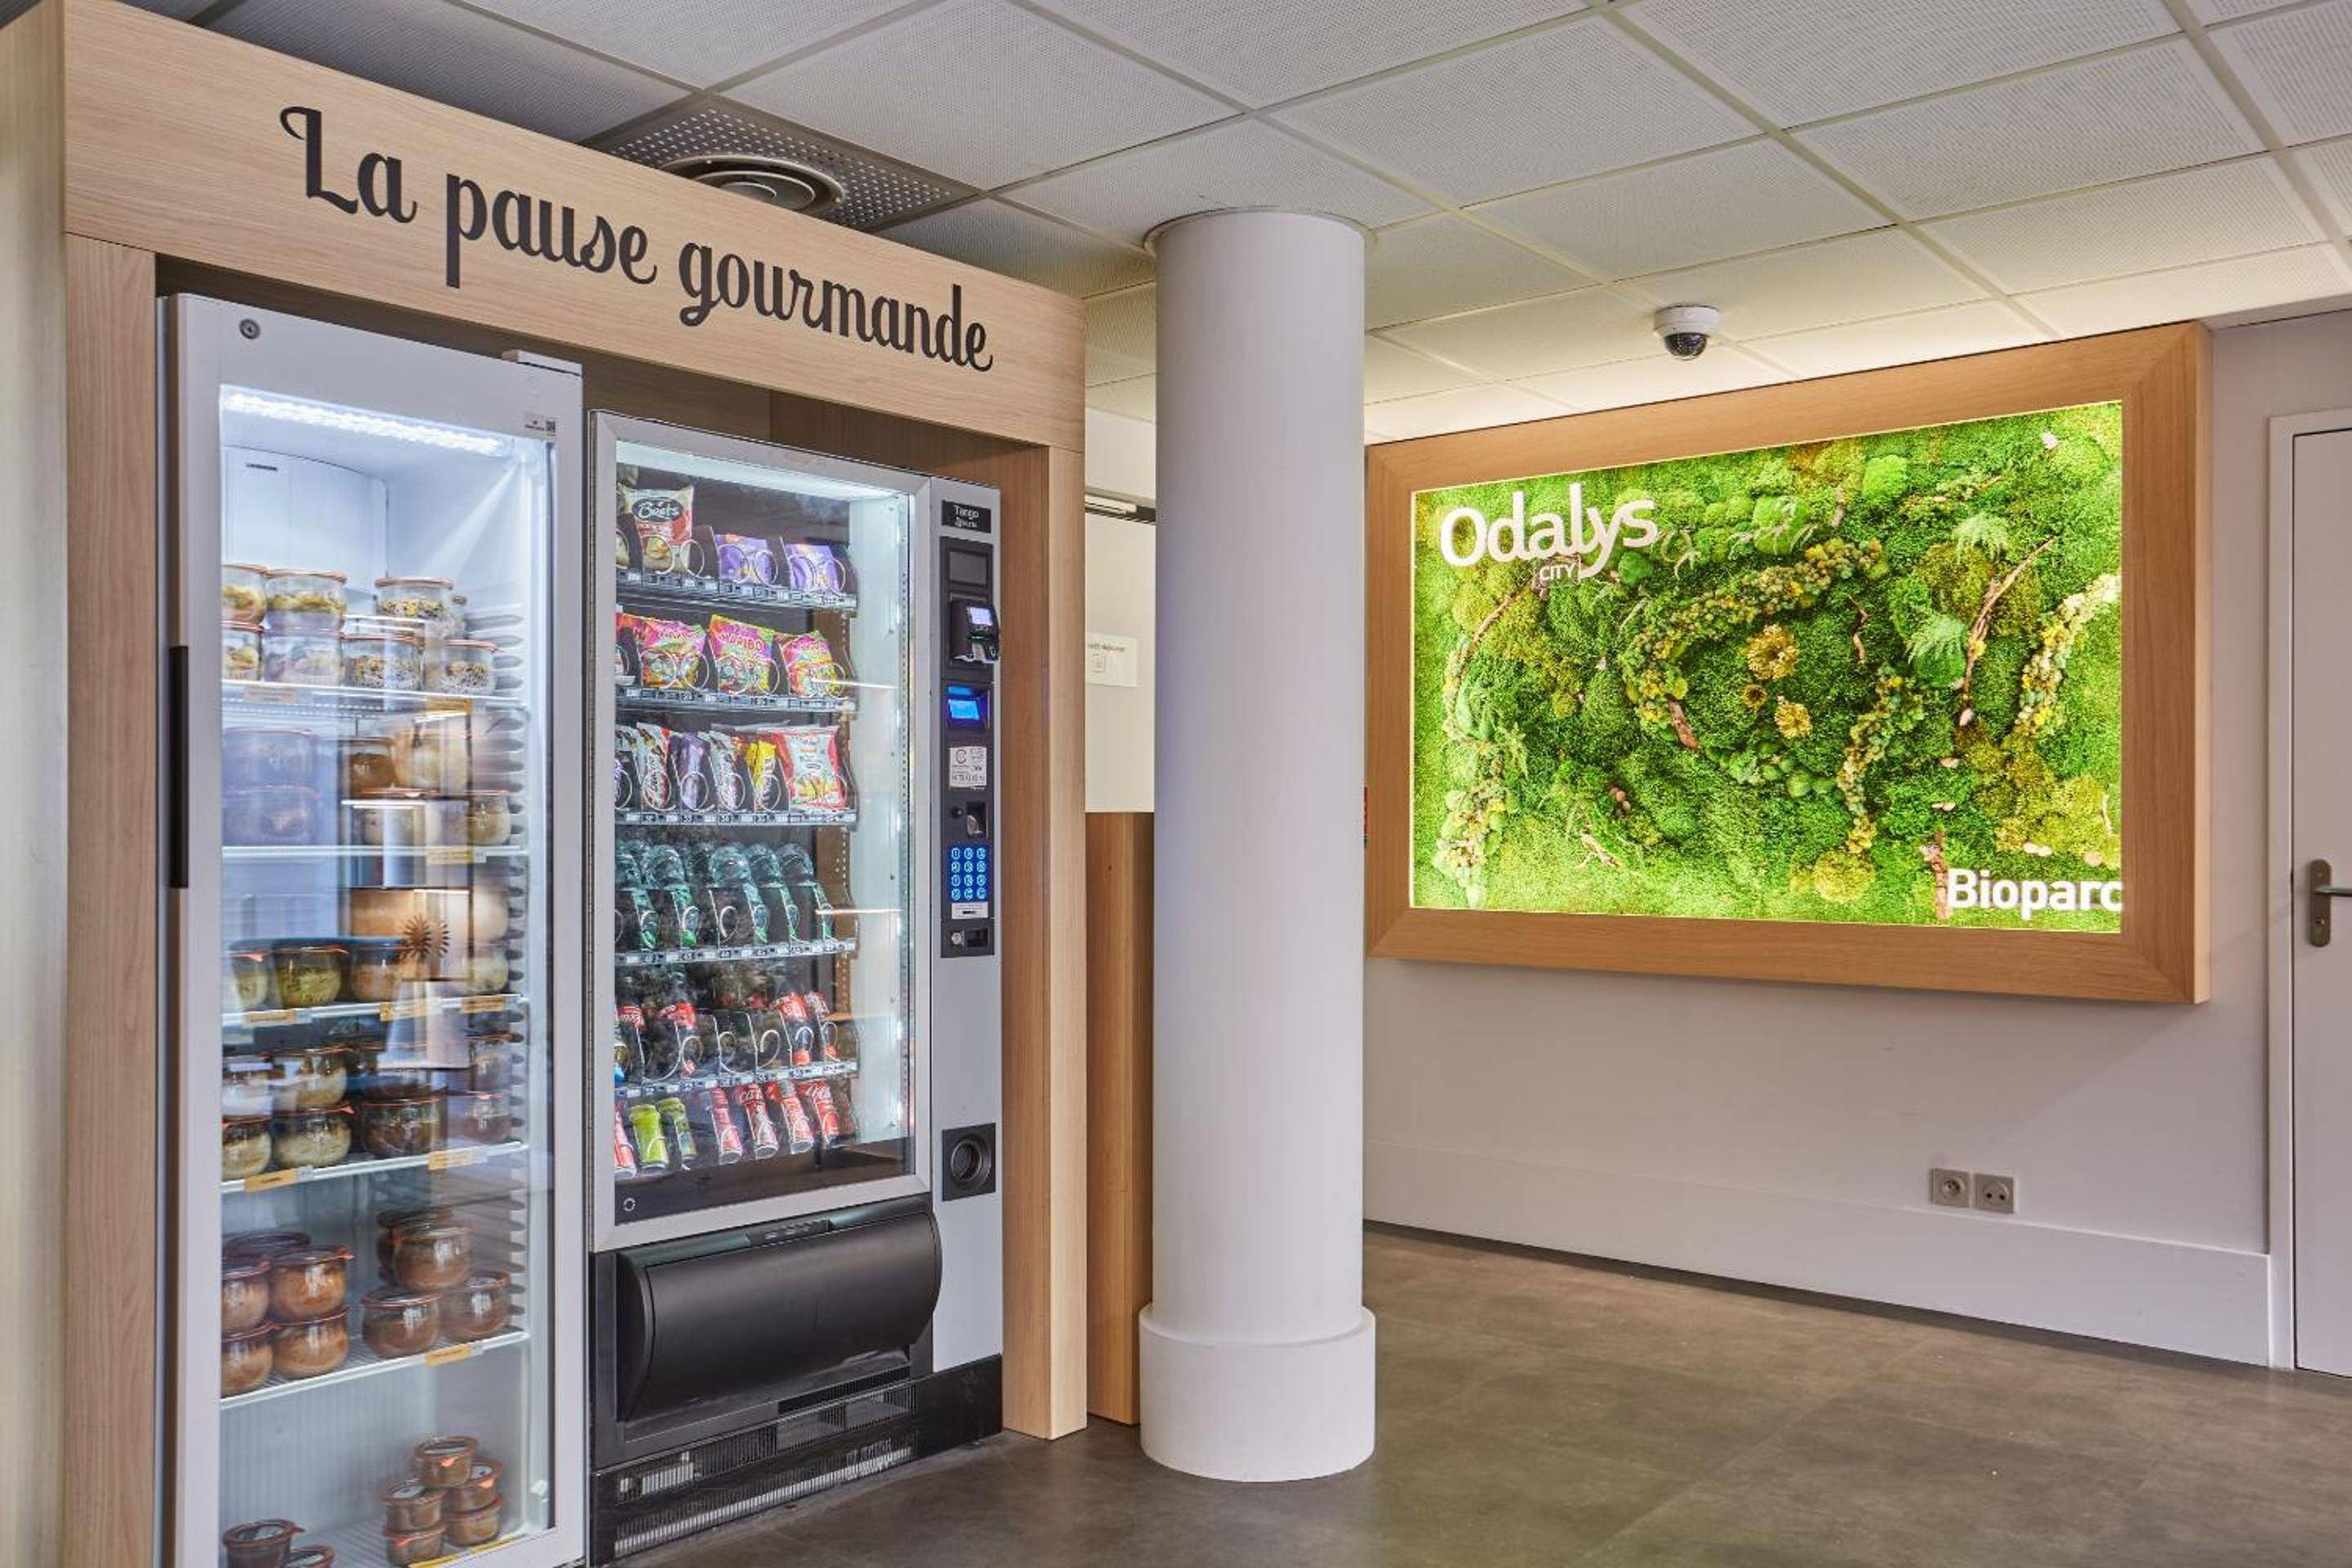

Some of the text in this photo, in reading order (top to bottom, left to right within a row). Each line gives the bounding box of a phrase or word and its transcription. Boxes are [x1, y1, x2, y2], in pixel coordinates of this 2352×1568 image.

[280, 105, 994, 372] La pause gourmande
[1440, 482, 1659, 579] Odalys
[1539, 563, 1576, 581] CITY
[1947, 867, 2122, 920] Bioparc
